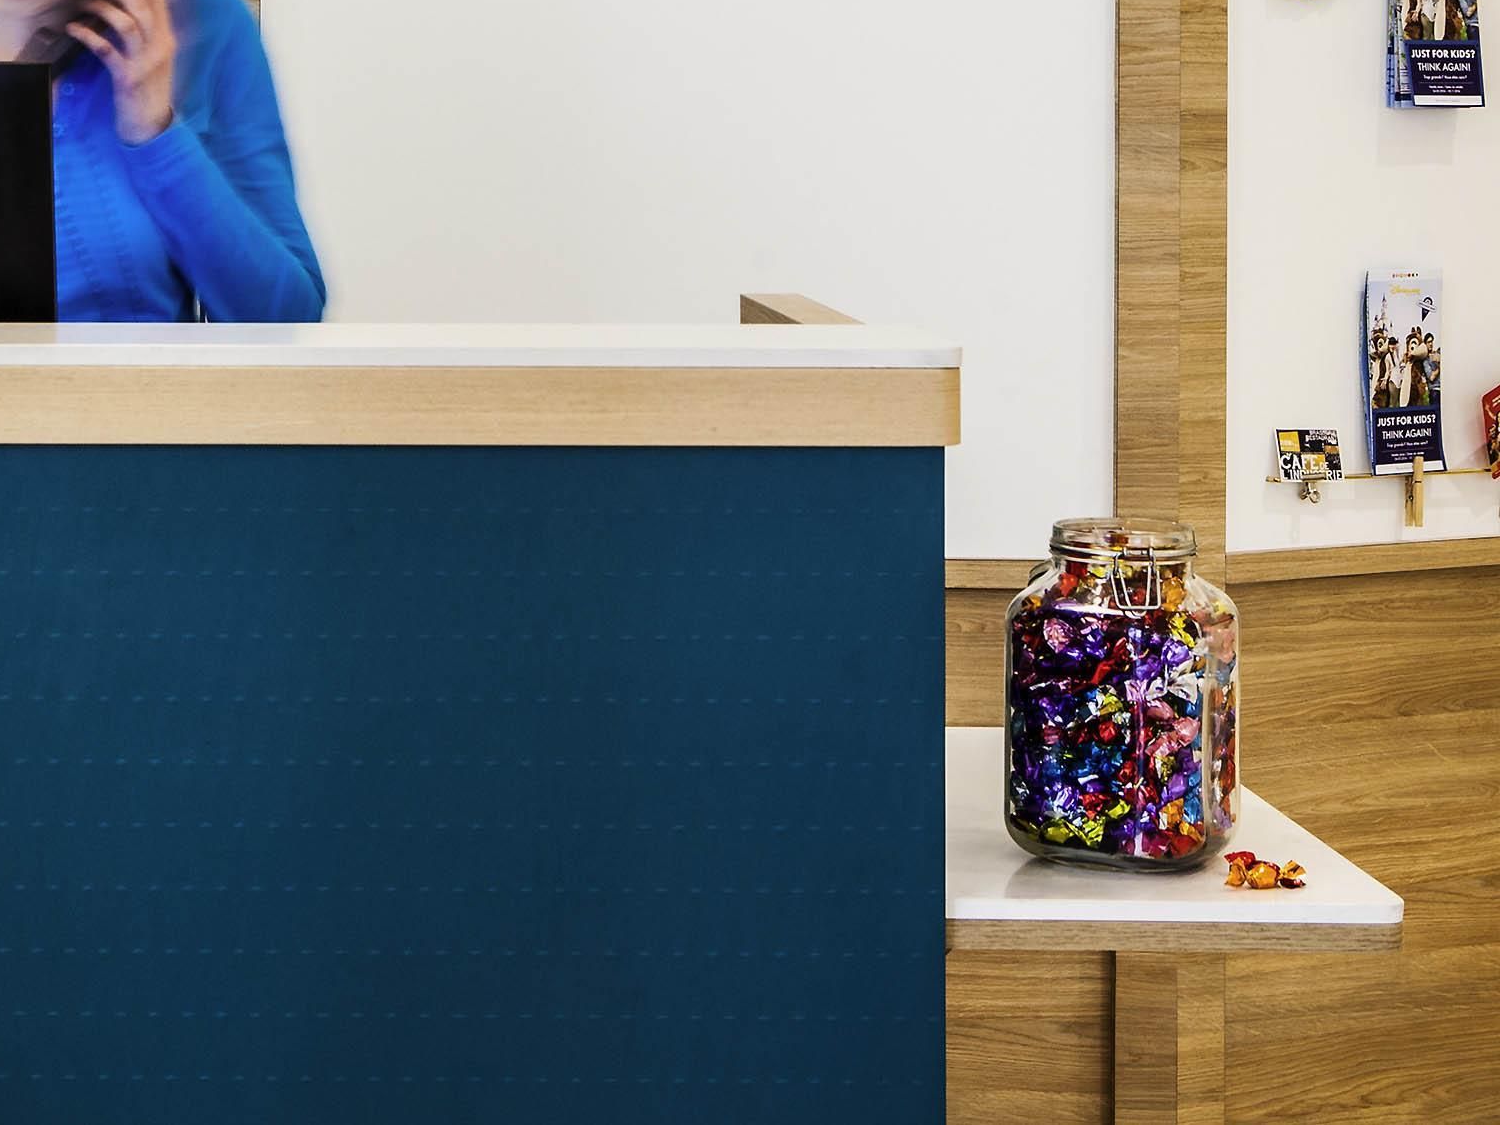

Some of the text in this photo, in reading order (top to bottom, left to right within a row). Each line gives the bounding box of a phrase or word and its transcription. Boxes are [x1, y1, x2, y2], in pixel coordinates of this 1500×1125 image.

[1411, 49, 1476, 59] JUST FOR KIDS?
[1417, 63, 1471, 72] THINK AGAIN!
[1377, 414, 1436, 427] JUST FOR KIDS?
[1382, 428, 1432, 440] THINK AGAIN!
[1319, 462, 1330, 470] DE
